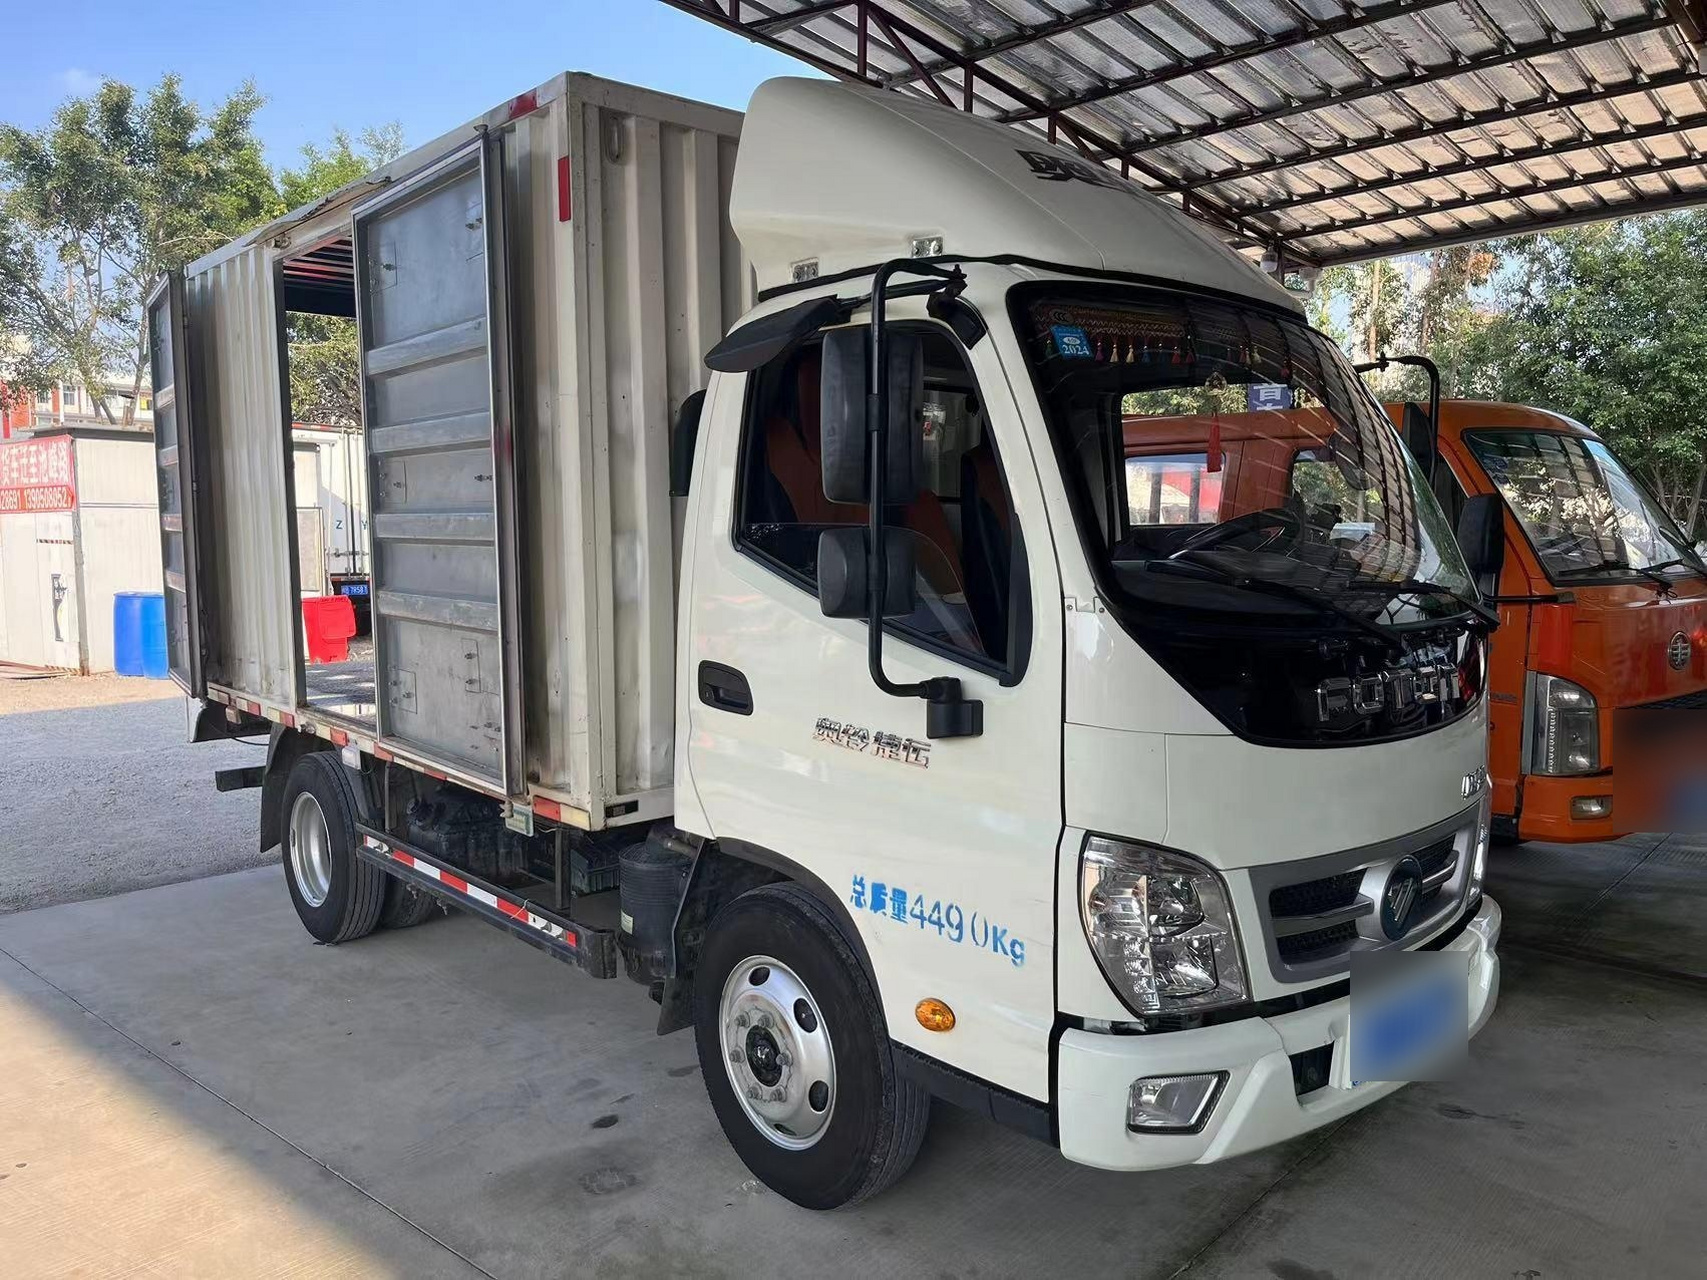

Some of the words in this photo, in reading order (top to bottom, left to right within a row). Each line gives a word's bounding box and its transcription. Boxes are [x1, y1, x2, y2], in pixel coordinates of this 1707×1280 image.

[1062, 344, 1090, 355] 2024
[0, 489, 21, 511] 28691
[336, 520, 343, 530] Z
